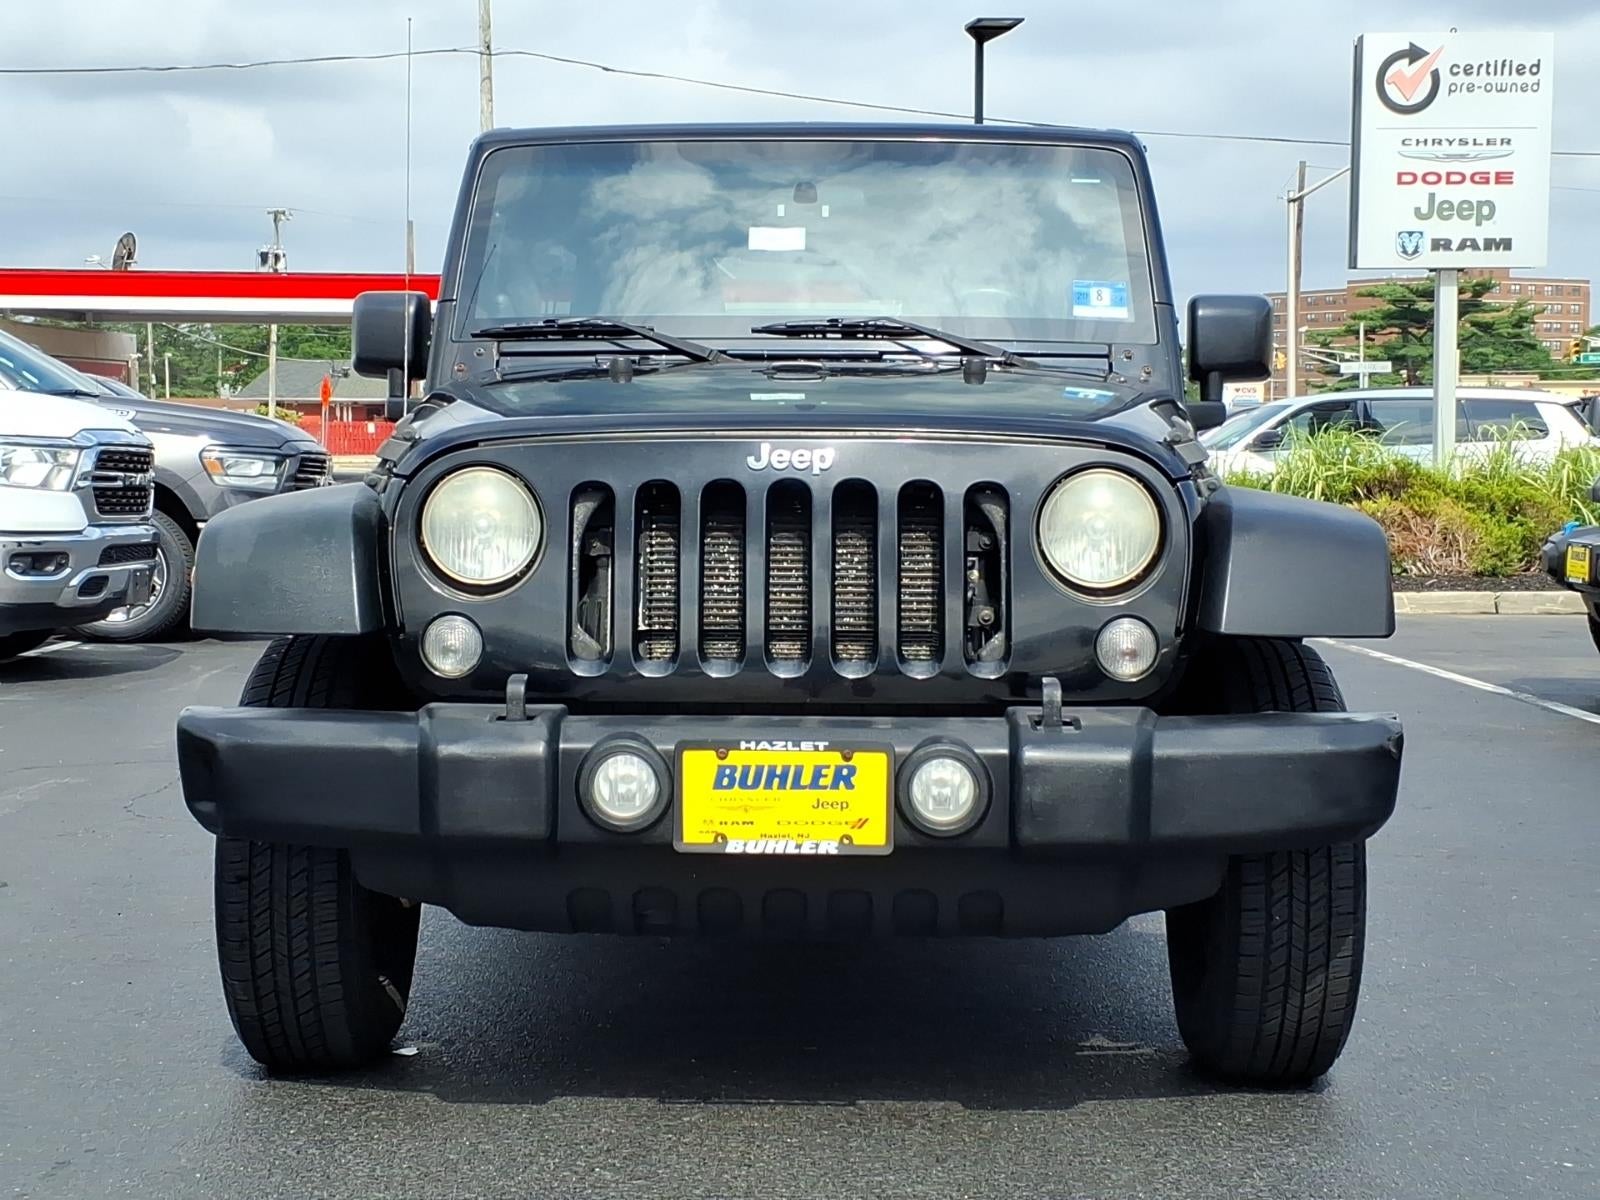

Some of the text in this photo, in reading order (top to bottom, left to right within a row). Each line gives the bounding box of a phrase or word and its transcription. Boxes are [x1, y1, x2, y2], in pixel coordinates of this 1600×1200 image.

[1449, 59, 1541, 76] certified
[1448, 79, 1541, 97] pre-owned
[1401, 138, 1512, 147] CHRYSLER
[1396, 171, 1514, 185] DODGE
[1414, 192, 1496, 226] Jeep
[1430, 238, 1512, 252] RAM
[1096, 289, 1103, 302] 8
[1241, 386, 1257, 394] CVS
[746, 442, 835, 476] Jeep
[740, 740, 829, 751] HAZLET
[712, 764, 857, 791] BUHLER
[812, 798, 850, 811] Jeep
[725, 839, 839, 855] BUHLER
